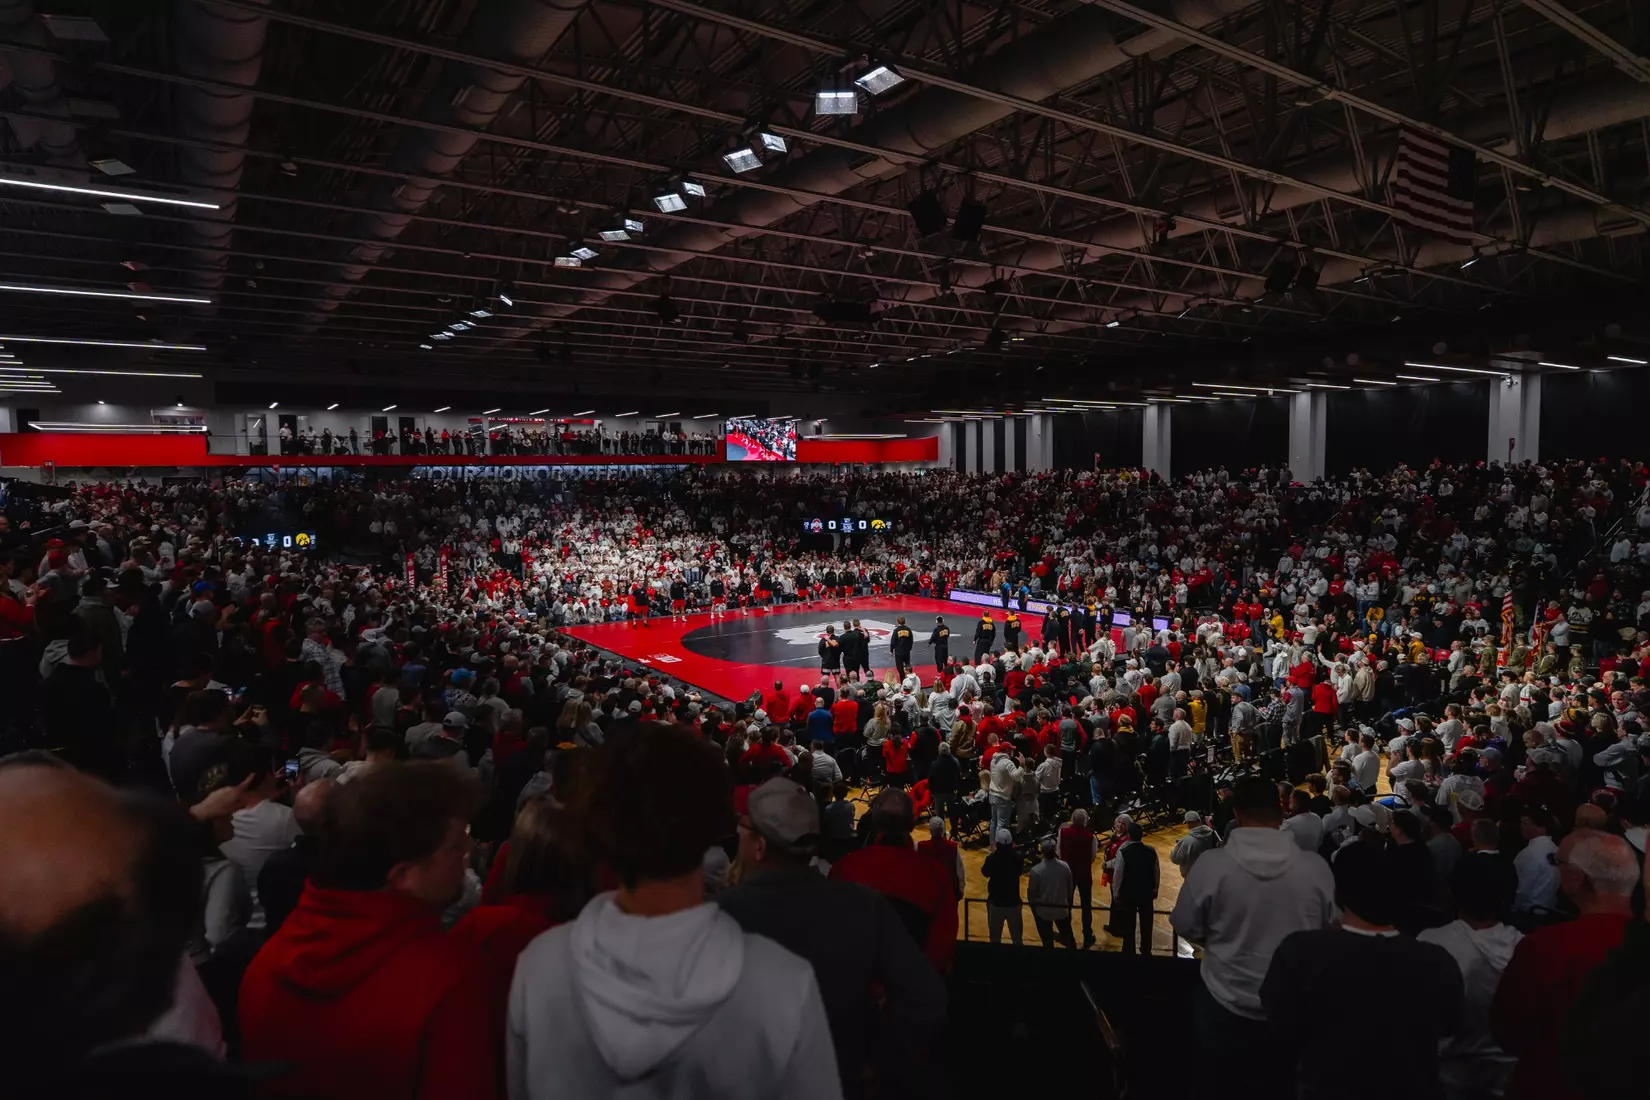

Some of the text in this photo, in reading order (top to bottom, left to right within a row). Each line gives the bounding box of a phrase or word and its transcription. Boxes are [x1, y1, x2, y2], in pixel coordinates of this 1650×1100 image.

[828, 520, 836, 529] 0
[858, 520, 867, 529] 0
[283, 535, 291, 548] 0
